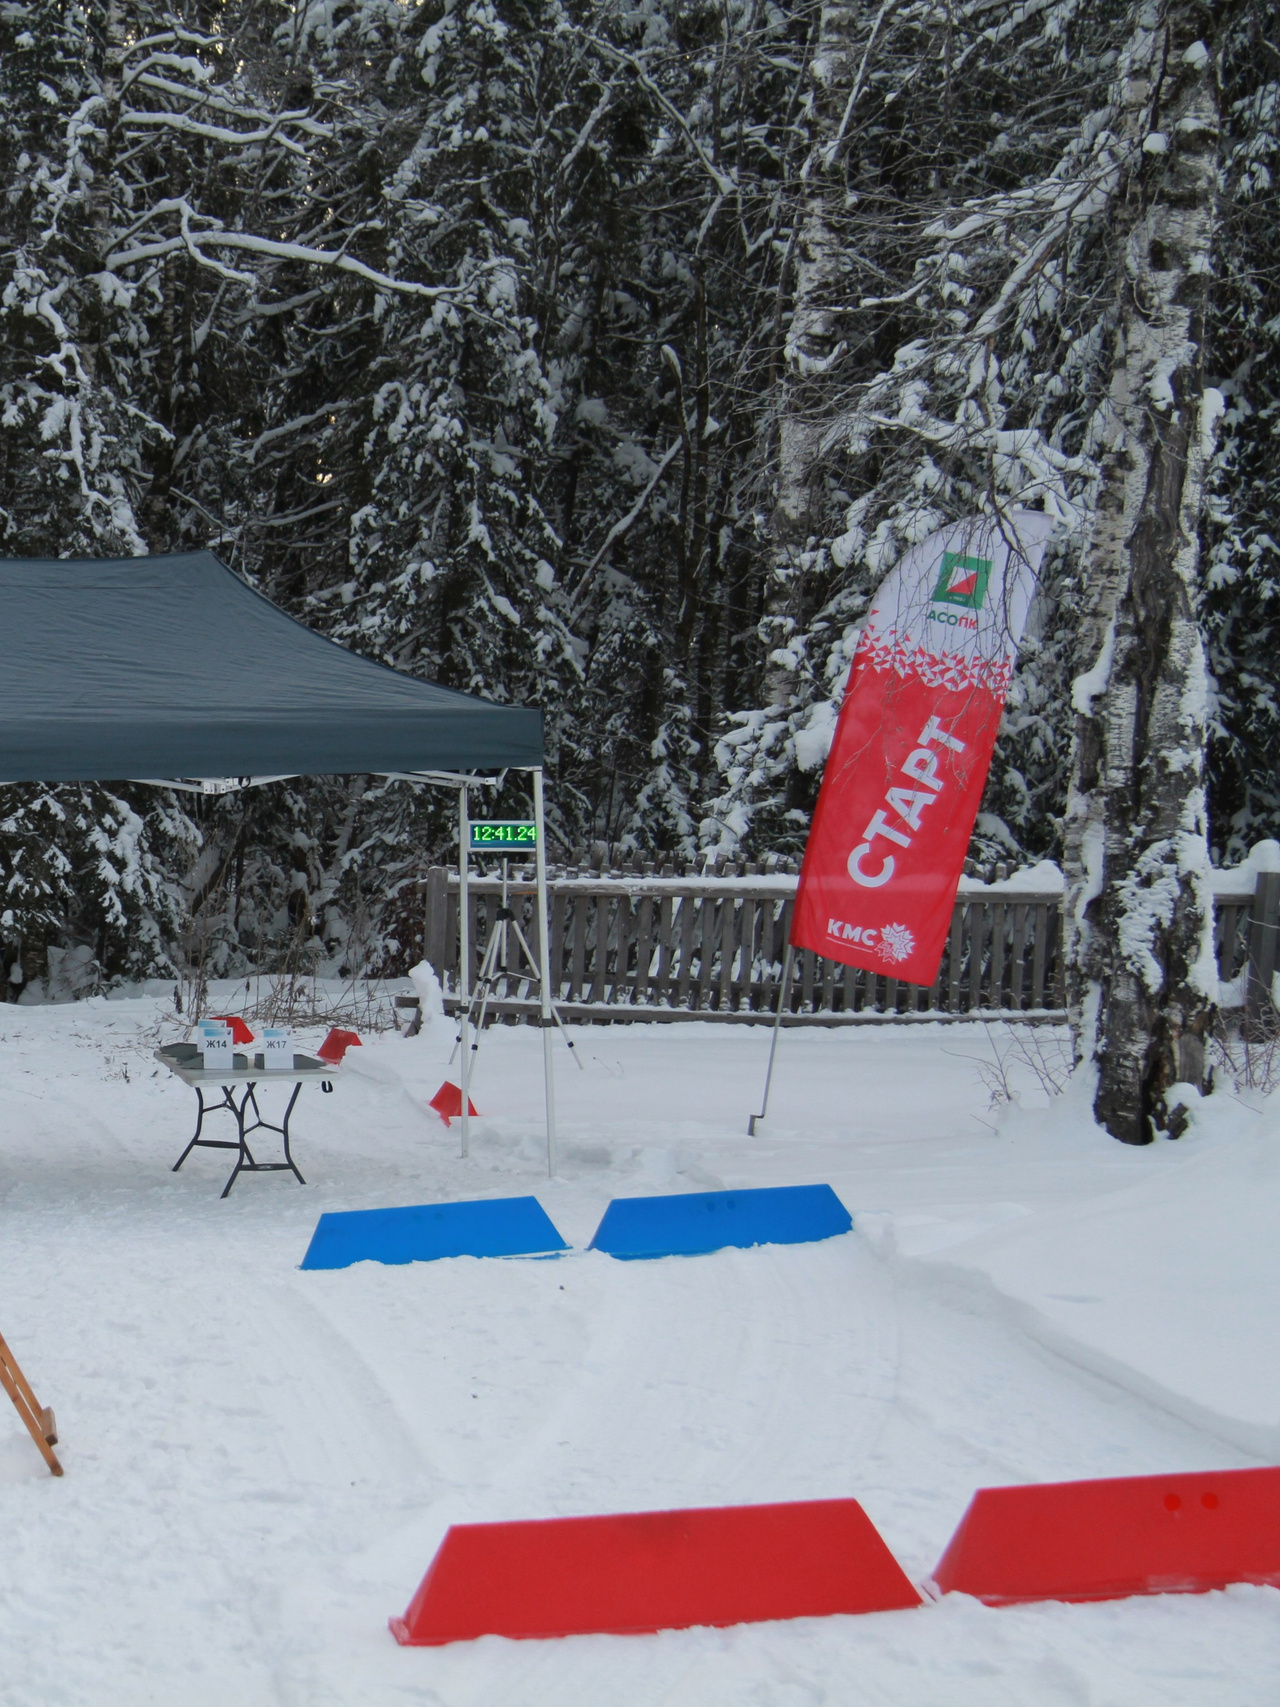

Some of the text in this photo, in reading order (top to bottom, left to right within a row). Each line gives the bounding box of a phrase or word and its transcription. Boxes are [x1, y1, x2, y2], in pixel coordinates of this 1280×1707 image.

[926, 610, 978, 630] АСОПК
[847, 715, 966, 888] СТАРТ
[474, 826, 536, 841] 12:41.24
[827, 918, 878, 946] КМС
[206, 1040, 227, 1048] Ж14
[266, 1040, 287, 1048] Ж17
